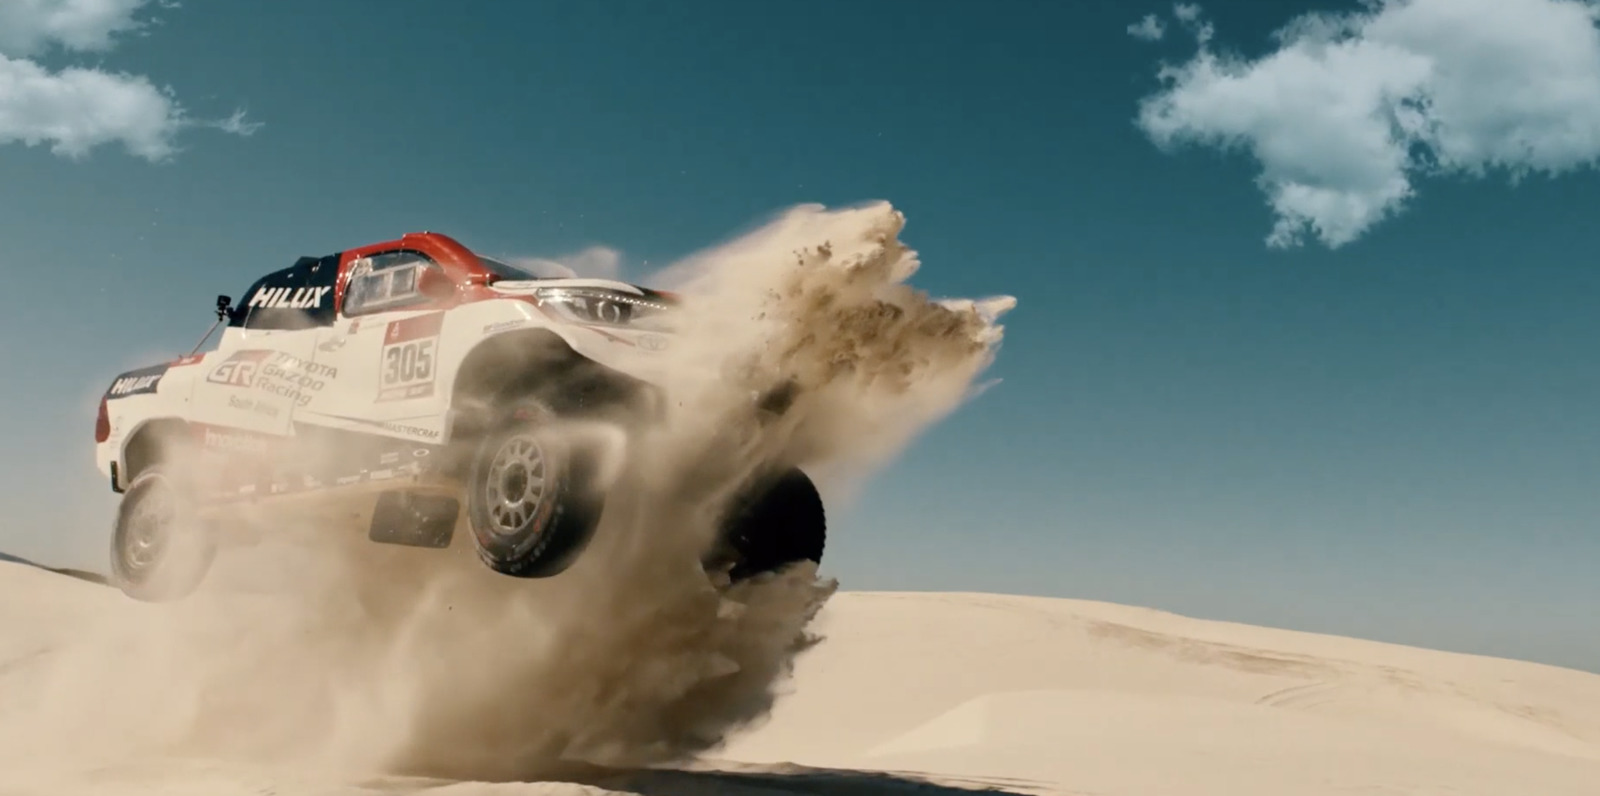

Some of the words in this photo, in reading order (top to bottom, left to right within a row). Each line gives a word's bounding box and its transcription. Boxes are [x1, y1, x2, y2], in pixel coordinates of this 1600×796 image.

[249, 286, 331, 309] HILUX
[208, 361, 258, 387] GR
[276, 351, 338, 380] TOYOTA
[385, 340, 432, 384] 305
[262, 363, 325, 391] GAZOO
[255, 376, 313, 407] Racing
